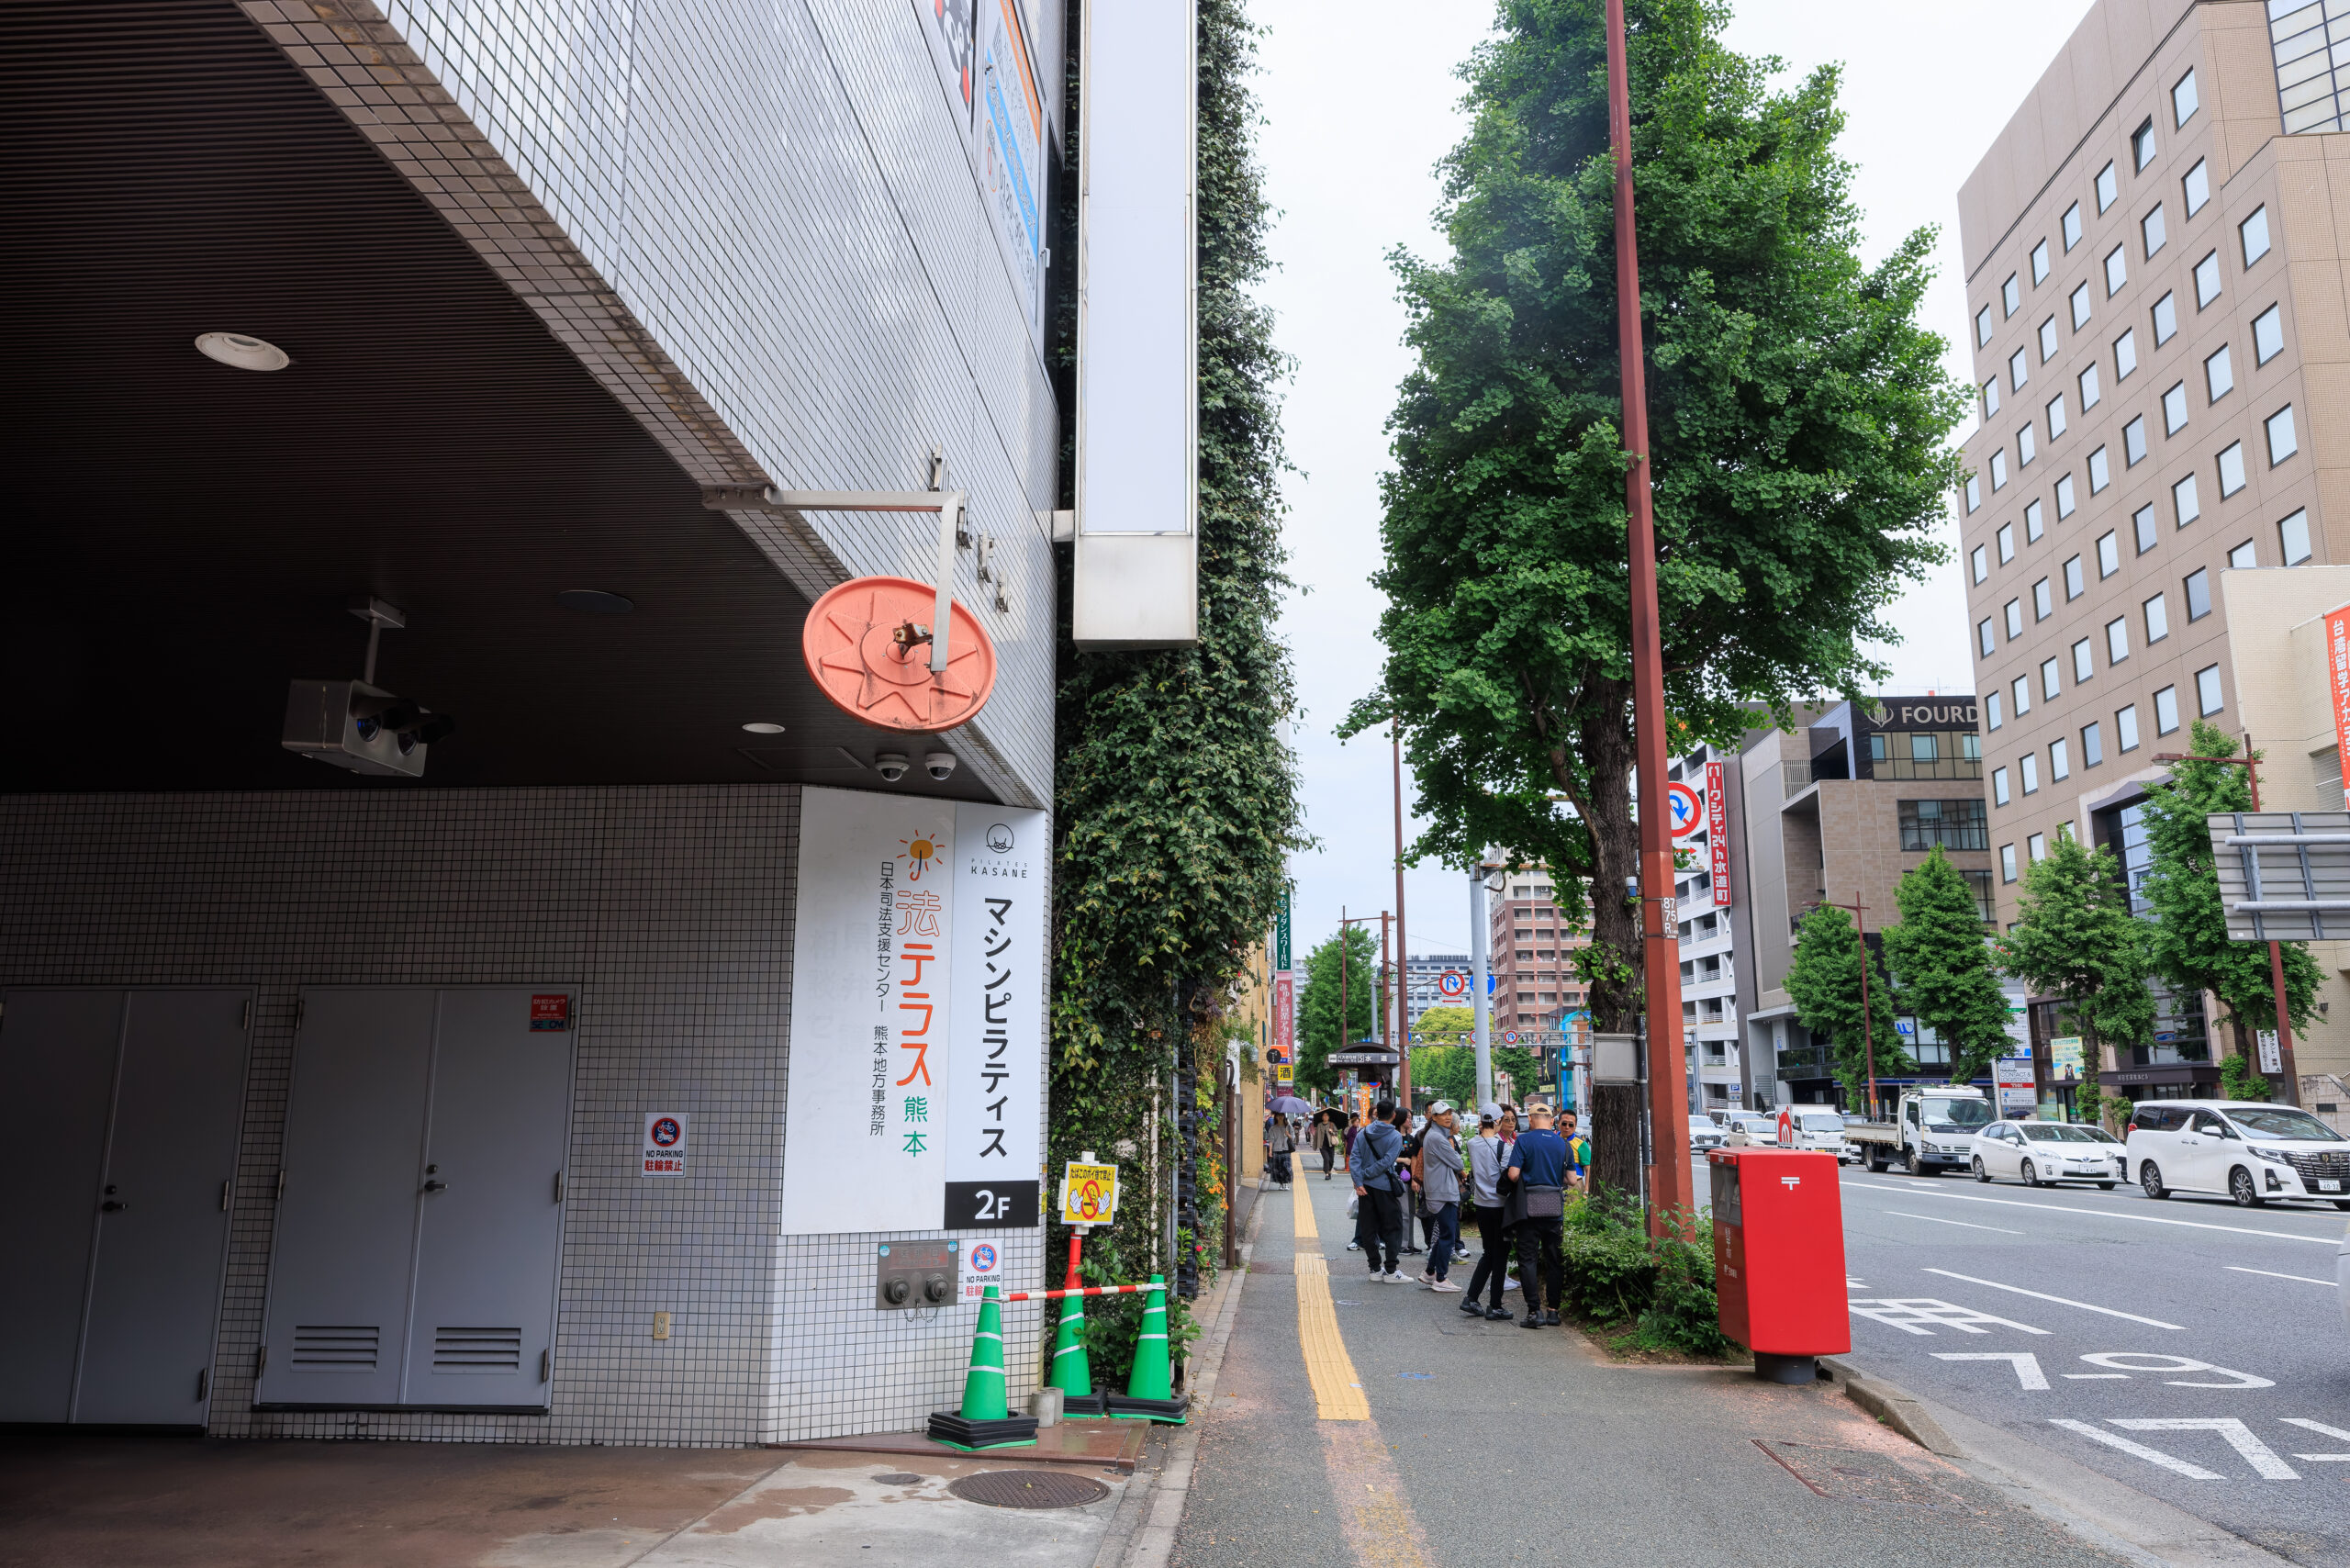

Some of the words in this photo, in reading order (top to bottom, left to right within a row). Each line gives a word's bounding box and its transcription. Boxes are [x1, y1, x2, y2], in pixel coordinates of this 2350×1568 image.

[970, 867, 1028, 879] KASANE
[1663, 897, 1675, 909] 87
[1664, 910, 1677, 922] 75
[1664, 922, 1672, 935] R
[532, 1020, 565, 1029] SECOM
[979, 897, 1013, 1159] マシンピラティス
[1281, 1067, 1292, 1079] 酒
[869, 1025, 890, 1137] 熊本地方事務所
[645, 1149, 655, 1158] NO
[655, 1149, 684, 1159] PARKING
[643, 1159, 683, 1172] 駐輪禁止
[975, 1189, 1011, 1220] 2F
[975, 1274, 1001, 1282] PARKING
